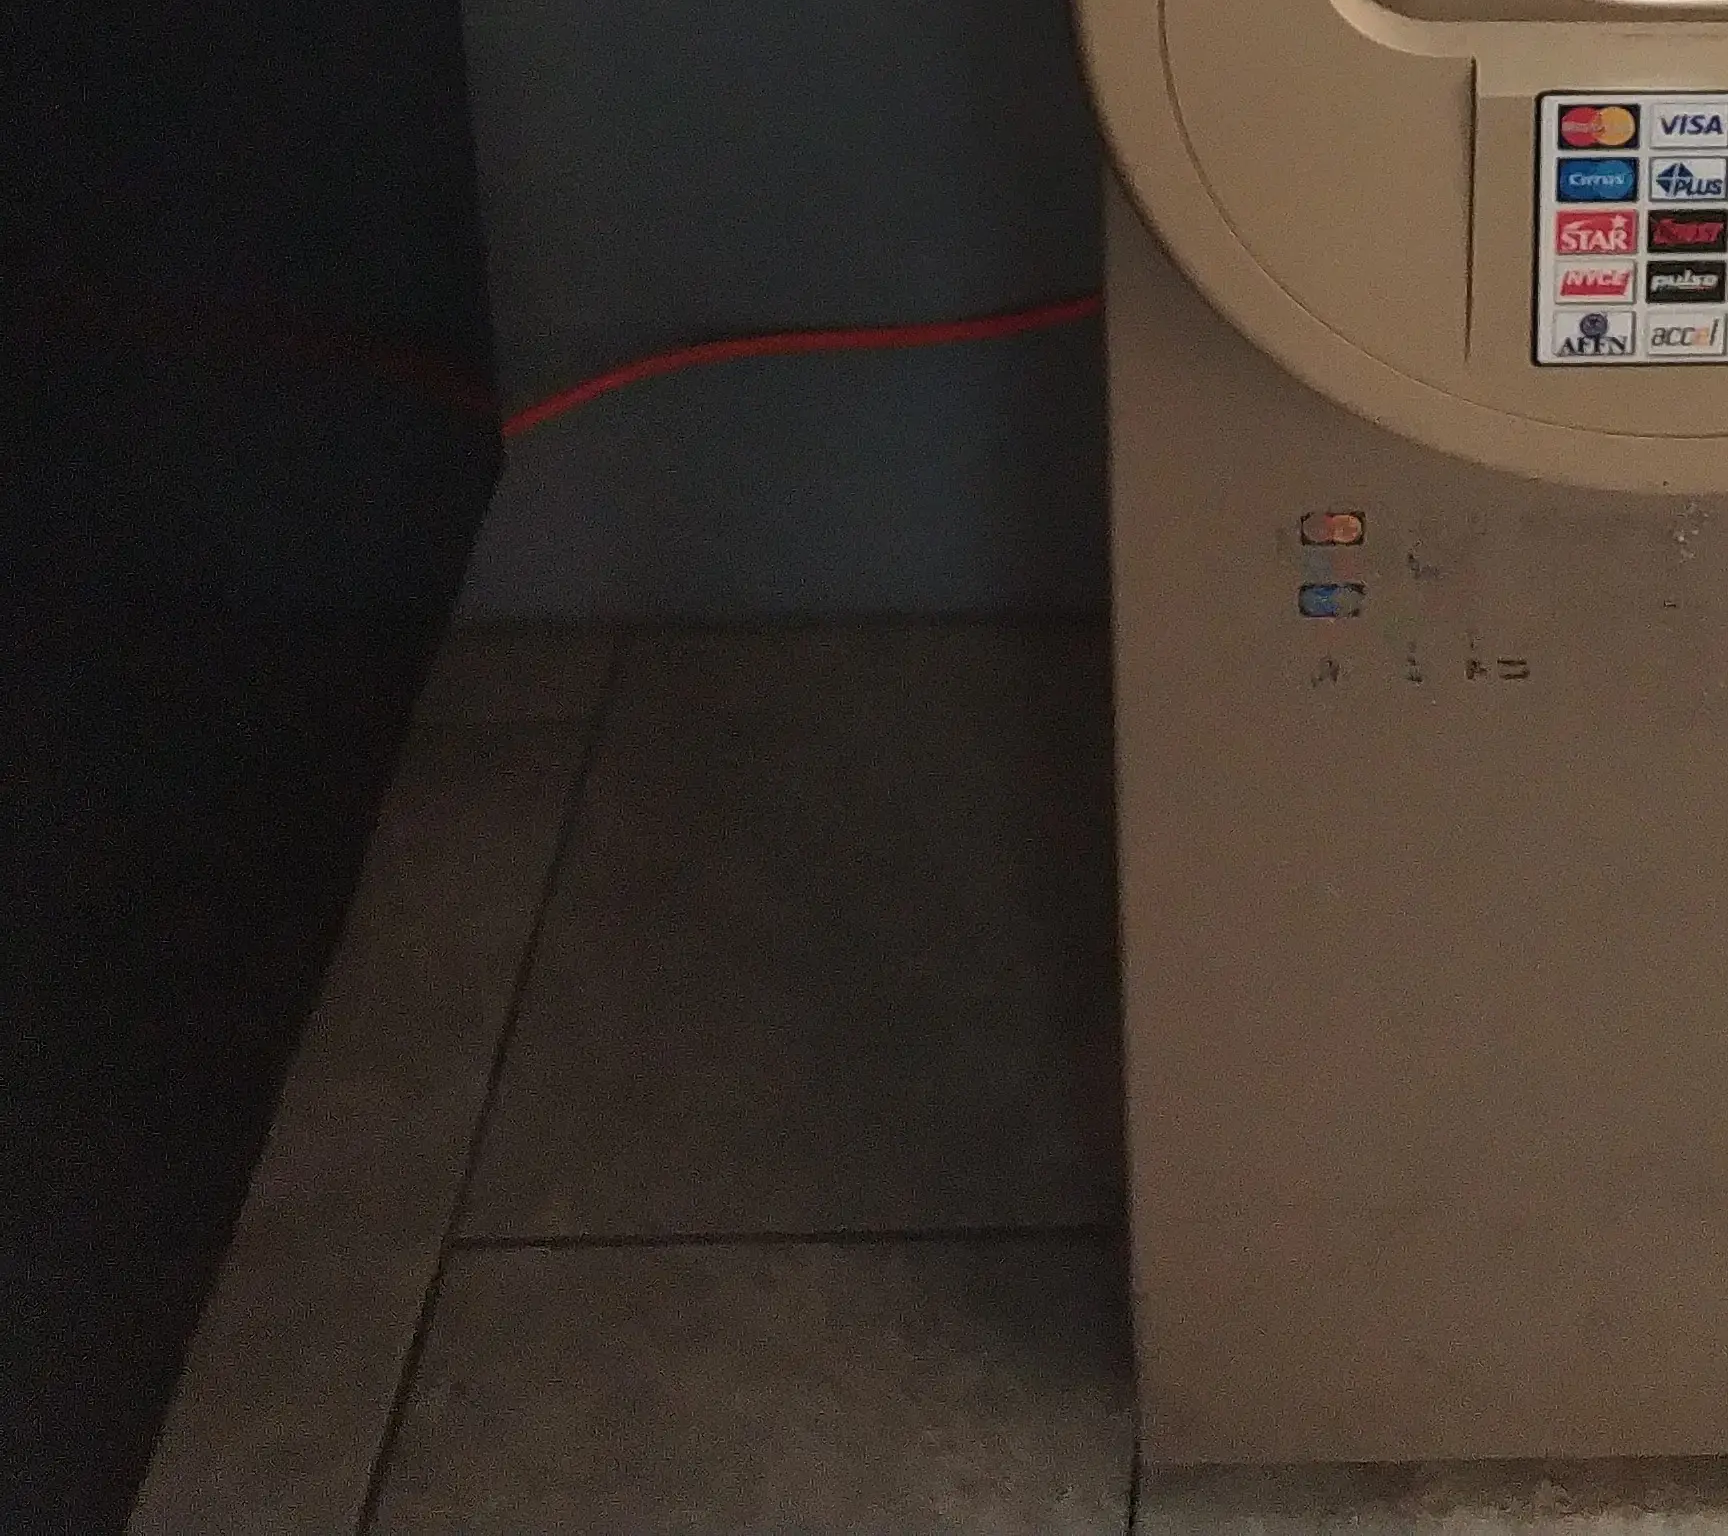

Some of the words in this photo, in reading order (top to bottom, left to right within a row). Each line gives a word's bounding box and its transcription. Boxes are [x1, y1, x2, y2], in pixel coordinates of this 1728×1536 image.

[1660, 113, 1724, 136] VISA
[1673, 178, 1724, 196] PLUS
[1560, 229, 1629, 251] STAR
[1651, 318, 1720, 347] accel
